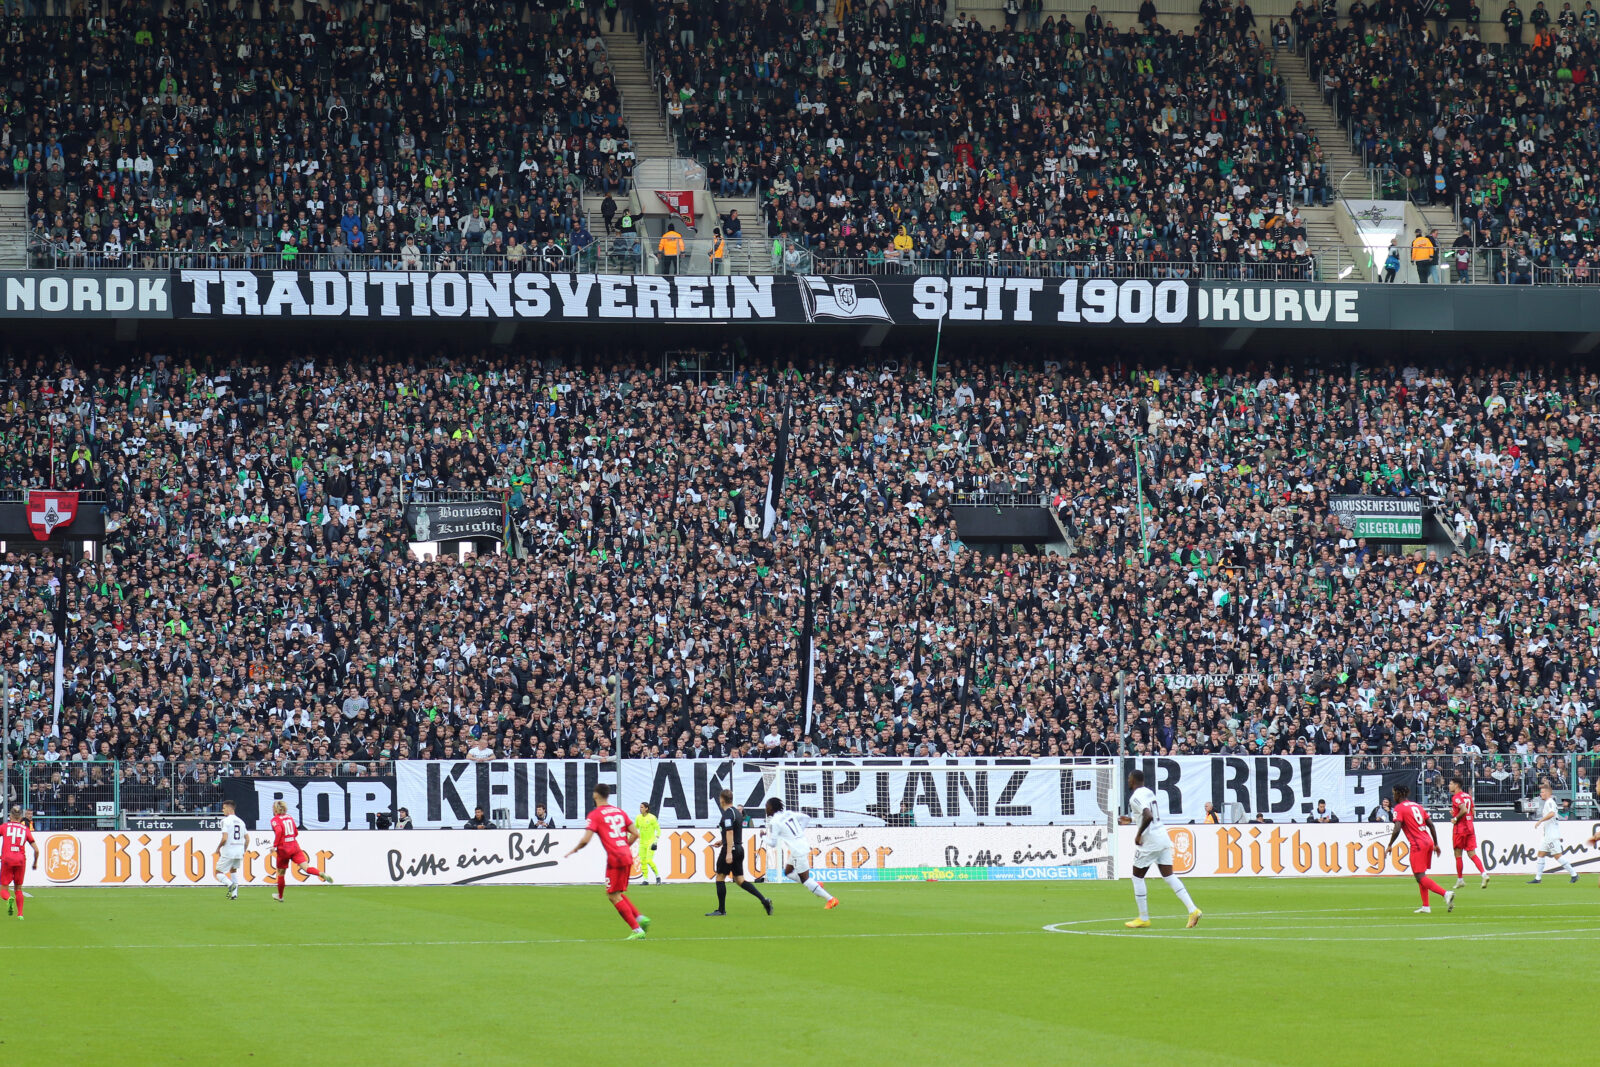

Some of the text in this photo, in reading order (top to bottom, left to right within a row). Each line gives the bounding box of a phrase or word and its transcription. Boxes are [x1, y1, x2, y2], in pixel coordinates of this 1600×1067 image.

[6, 277, 168, 312] NORDK
[180, 270, 1189, 324] TRADITIONSVEREIN SEIT 1900
[438, 506, 502, 520] Borussen
[1329, 500, 1420, 512] BORUSSENFESTUNG
[437, 521, 503, 534] Knights
[1359, 522, 1420, 535] SIEGERLAND
[427, 762, 618, 821] KEINE
[649, 758, 1032, 821] AKZEPTANZ
[1211, 756, 1313, 814] RB!
[136, 820, 173, 829] flatex
[199, 820, 223, 829] flat
[1411, 806, 1424, 825] 8
[1474, 810, 1502, 819] latex
[6, 826, 27, 846] 44
[233, 825, 241, 840] 8
[283, 819, 294, 836] 10
[604, 814, 627, 838] 32
[785, 817, 800, 837] 17
[388, 832, 559, 881] Bitte ein Bit
[666, 830, 894, 881] Bibrger
[1012, 843, 1057, 865] ein
[1061, 828, 1108, 857] Bit
[1214, 826, 1410, 875] Bitburge
[1481, 839, 1538, 871] Bitte
